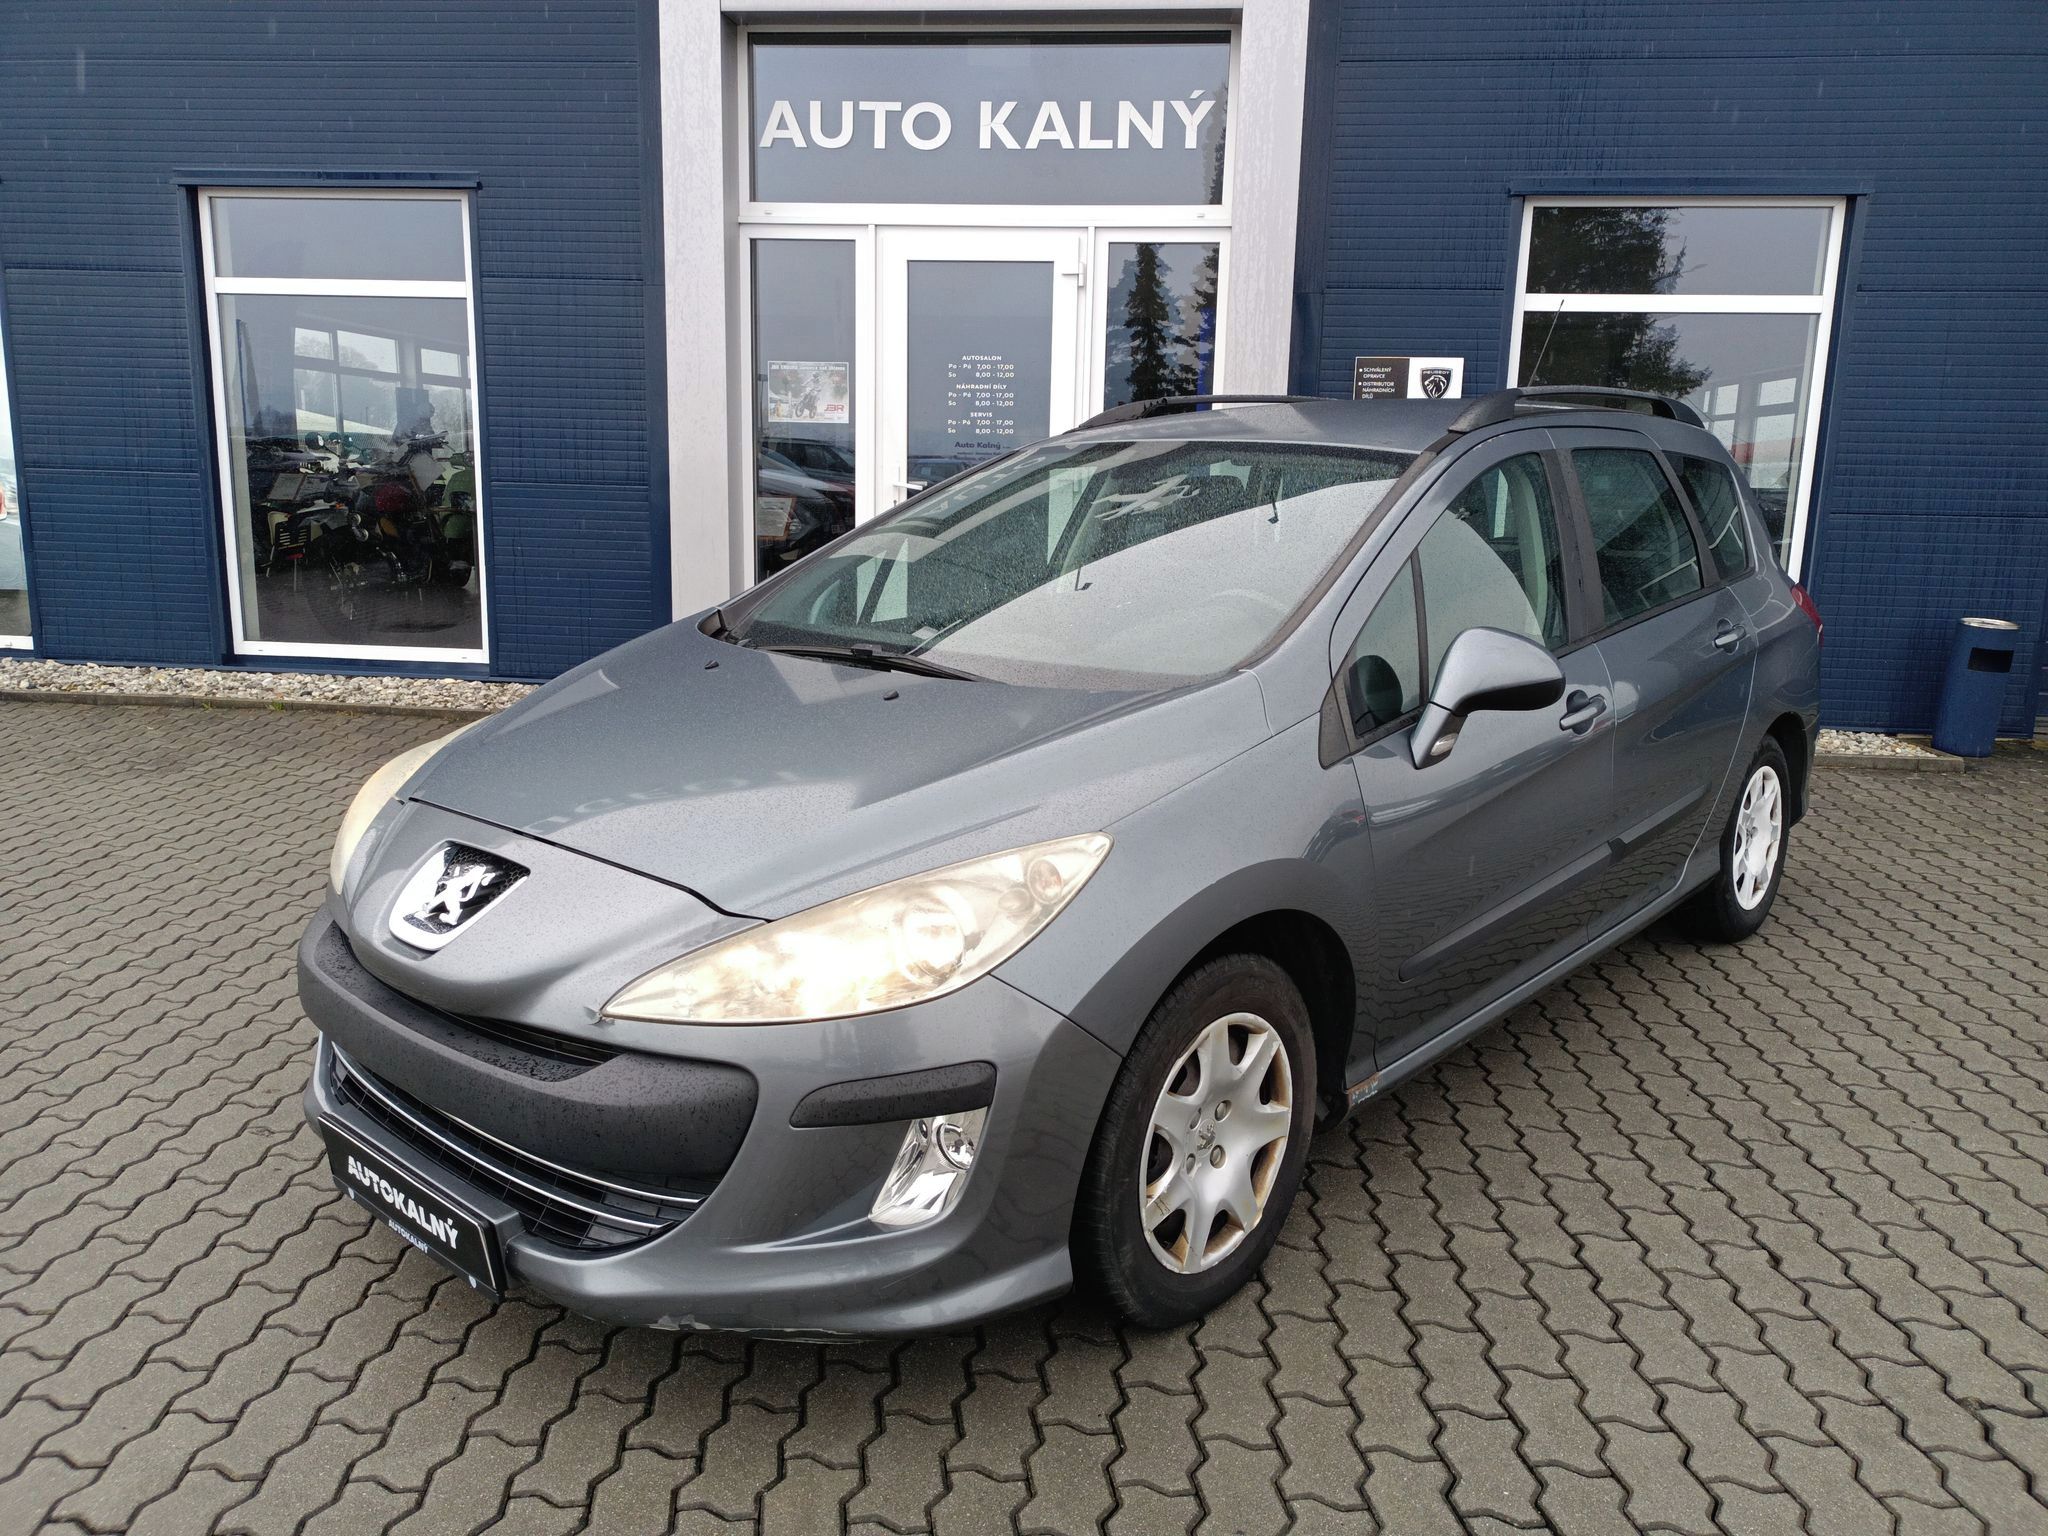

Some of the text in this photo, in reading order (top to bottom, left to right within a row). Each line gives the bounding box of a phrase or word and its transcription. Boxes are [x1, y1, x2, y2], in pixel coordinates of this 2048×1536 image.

[759, 89, 1217, 151] AUTO KALNÝ
[956, 382, 1007, 390] NÁHRADNÍ DÍLY
[977, 442, 1001, 450] Kalný
[348, 1155, 458, 1249] AUTOKALNÝ
